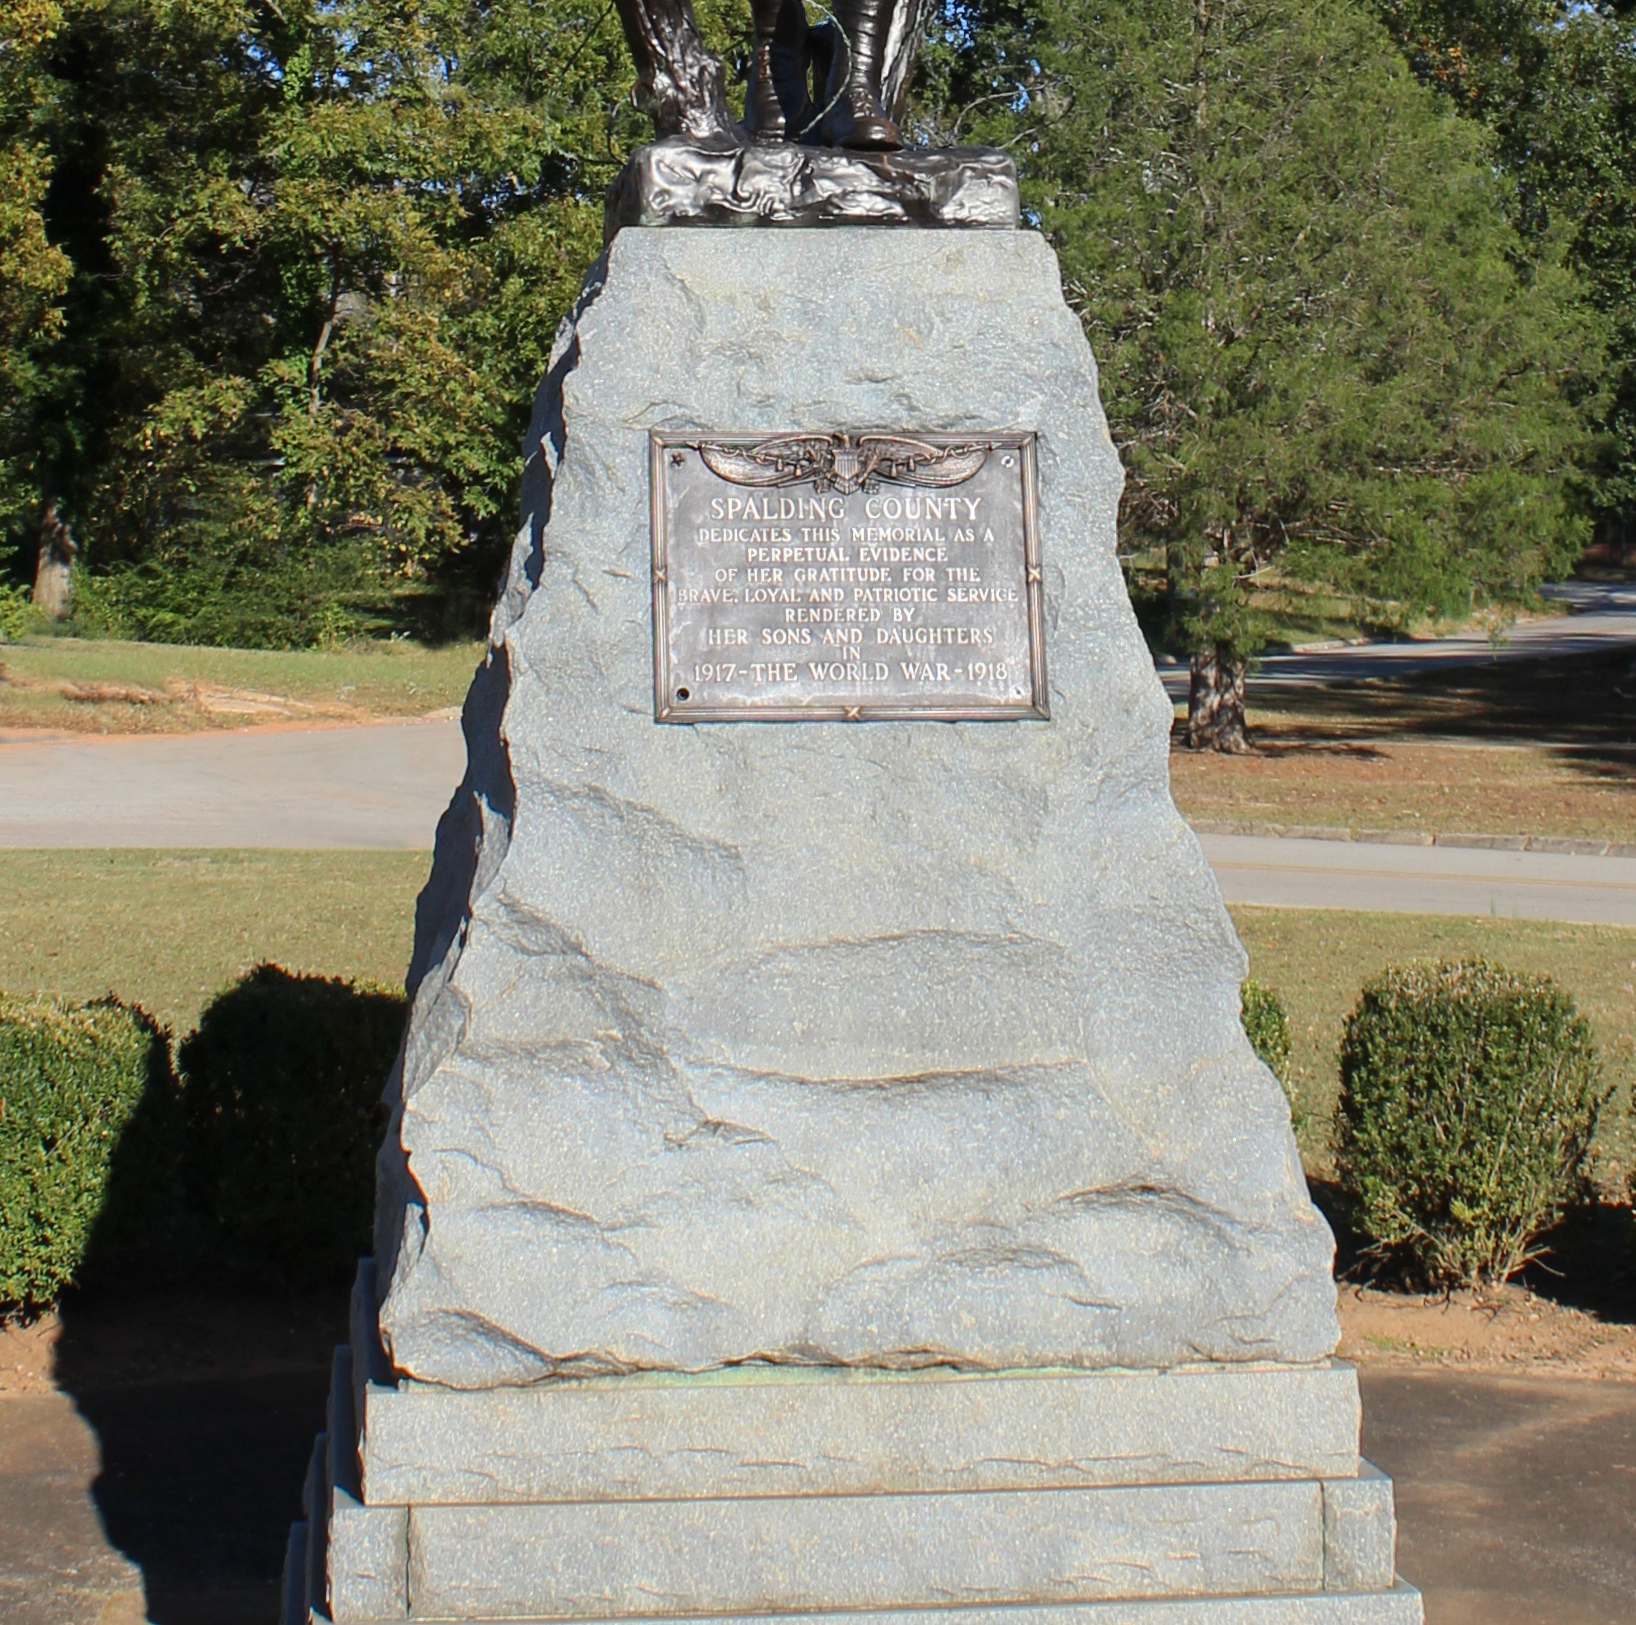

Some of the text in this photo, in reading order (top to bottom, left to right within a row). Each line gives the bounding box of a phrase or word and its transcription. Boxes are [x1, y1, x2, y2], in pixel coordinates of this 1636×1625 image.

[711, 497, 982, 521] SPALDING COUNTY
[699, 528, 994, 542] DEDICATES THIS MEMORIAL AS A
[748, 548, 948, 562] PERPETUAL EVIDENCE
[715, 568, 980, 582] OF HER GRATITUDE FOR THE
[745, 589, 801, 603] LOYAL
[810, 588, 844, 602] AND
[854, 588, 938, 602] PATRIOTIC
[947, 588, 1018, 602] SERVICE
[785, 608, 915, 622] RENDERED BY
[708, 628, 993, 644] HER SONS AND DAUGHTERS
[842, 646, 860, 659] IN
[809, 663, 888, 680] WORLD
